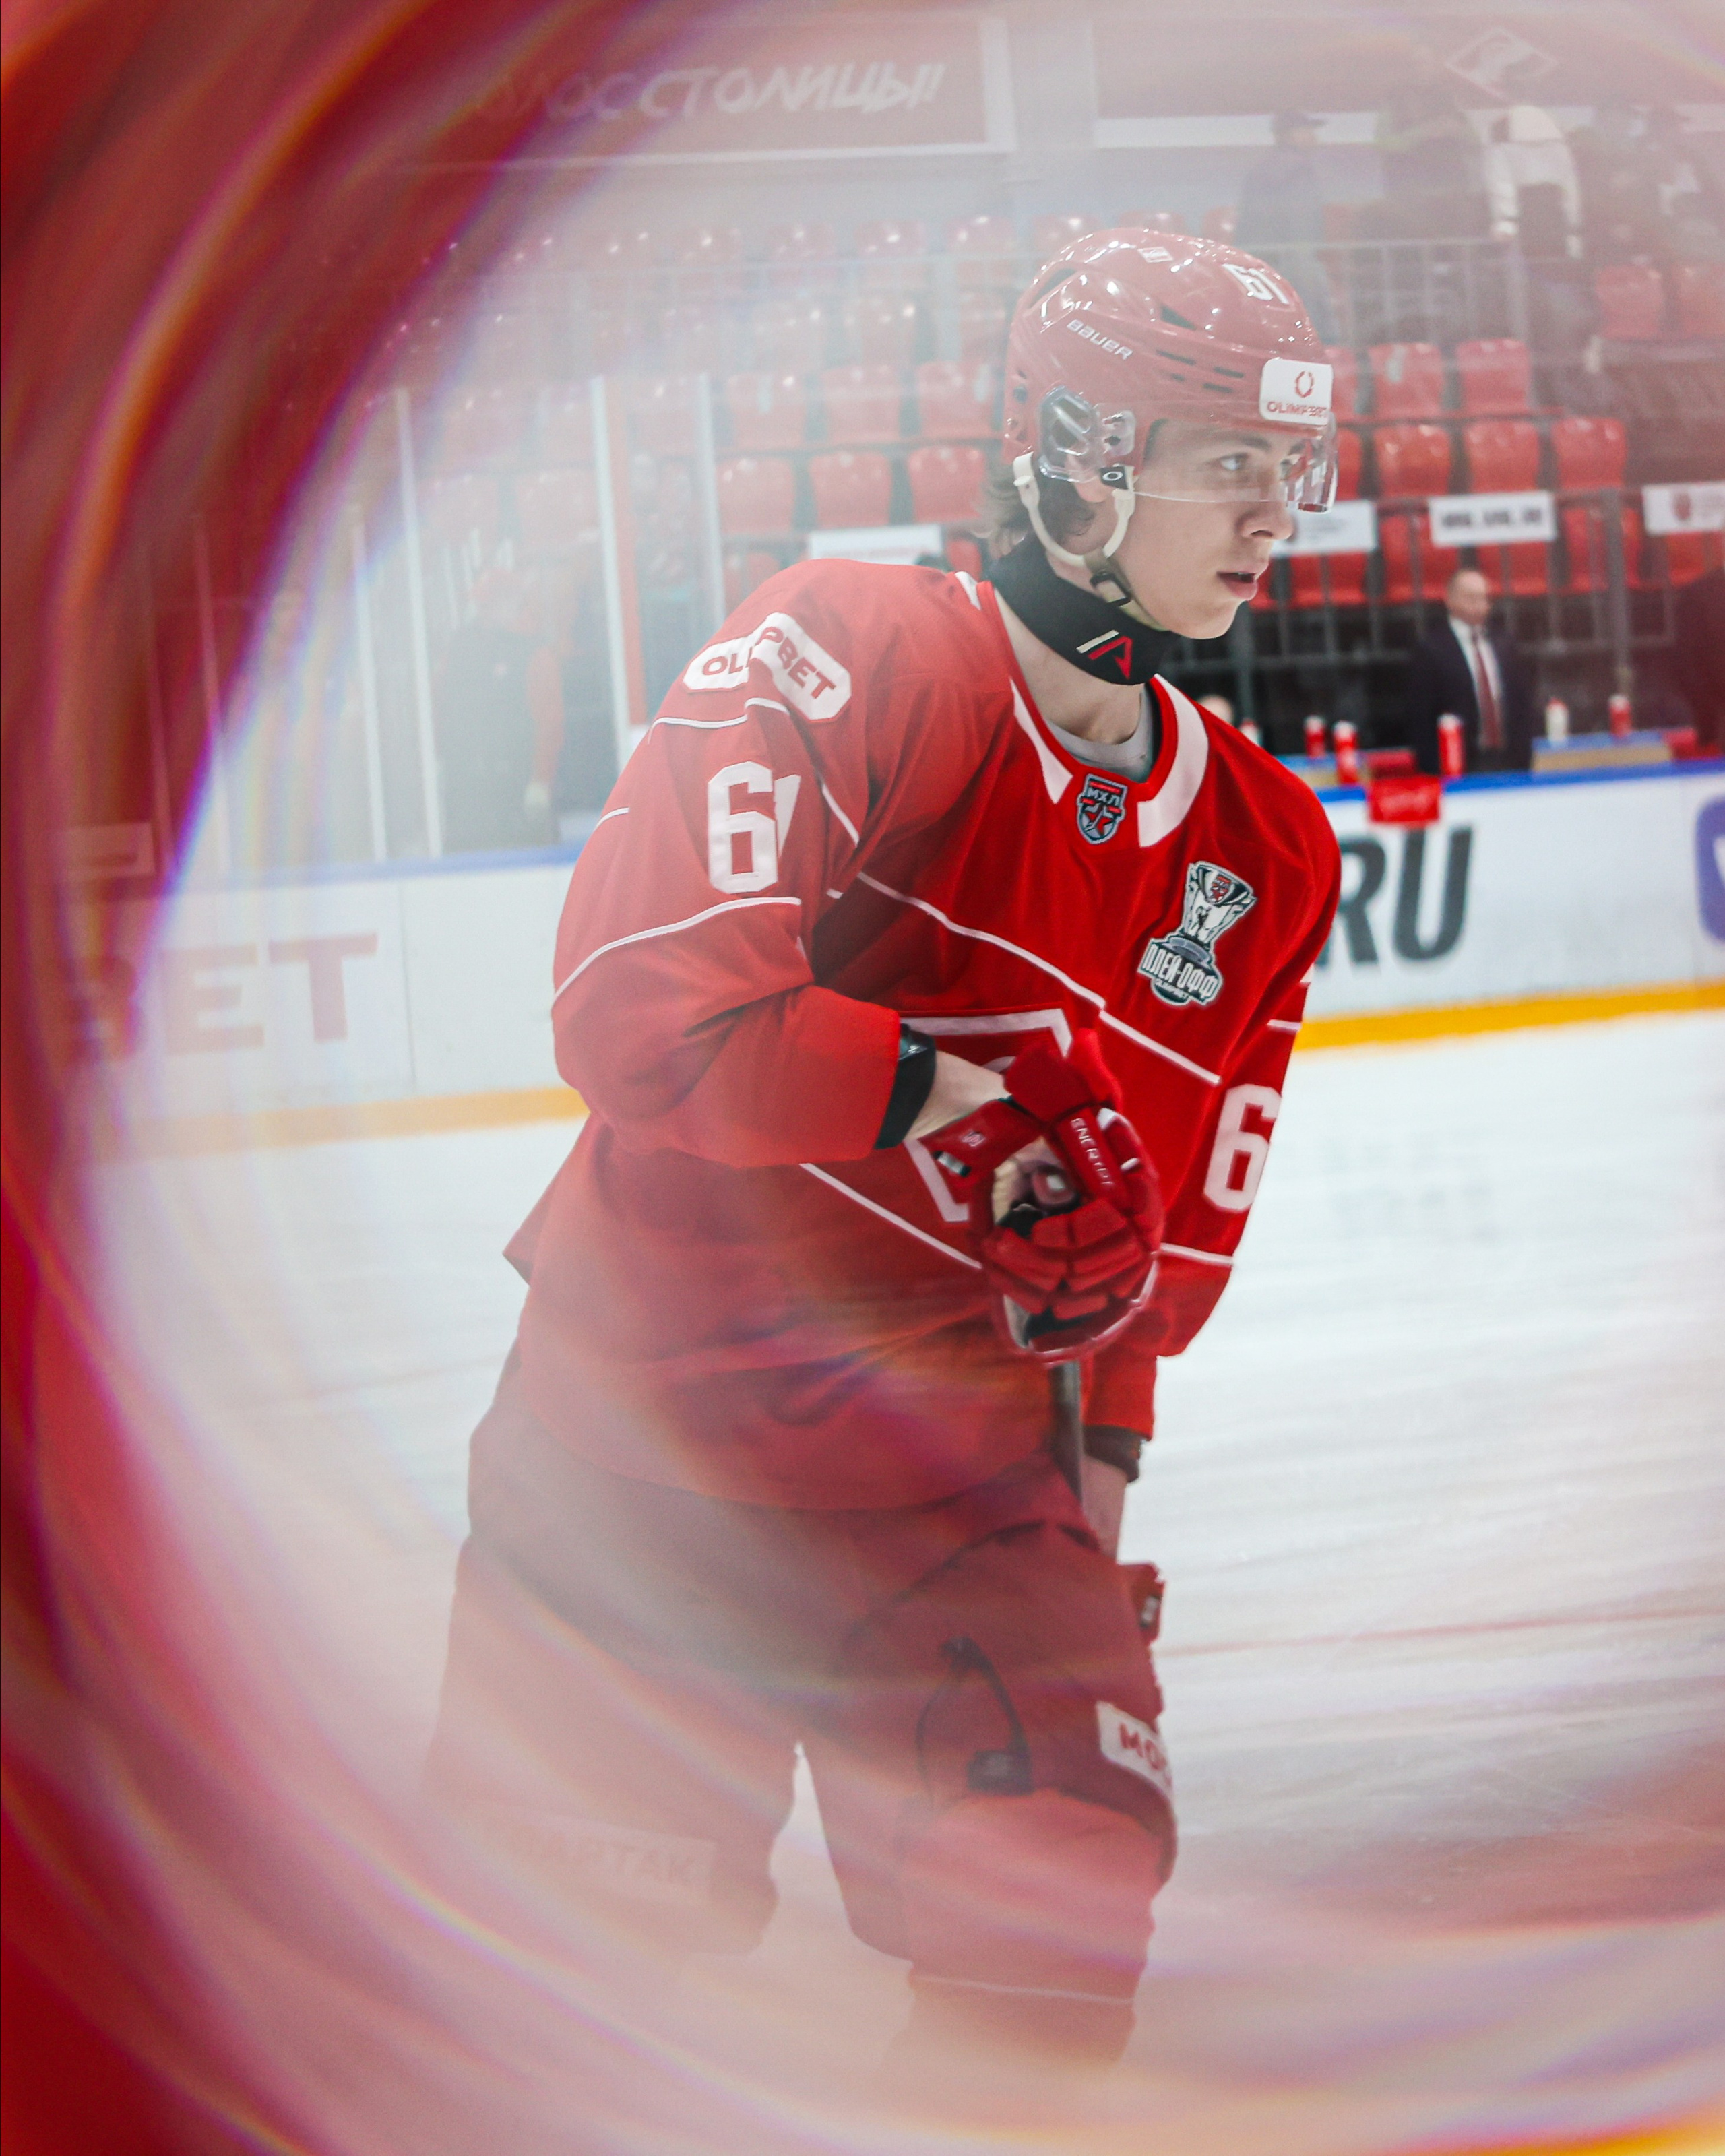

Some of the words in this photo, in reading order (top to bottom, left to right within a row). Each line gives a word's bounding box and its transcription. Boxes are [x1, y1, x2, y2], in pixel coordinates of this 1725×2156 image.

[1221, 263, 1290, 305] 61
[1067, 319, 1133, 360] BAUER
[702, 626, 836, 699] OLPBET
[708, 761, 801, 895] 61
[1086, 786, 1120, 807] МХЛ
[1203, 1083, 1282, 1211] 6
[1119, 1722, 1173, 1789] МО
